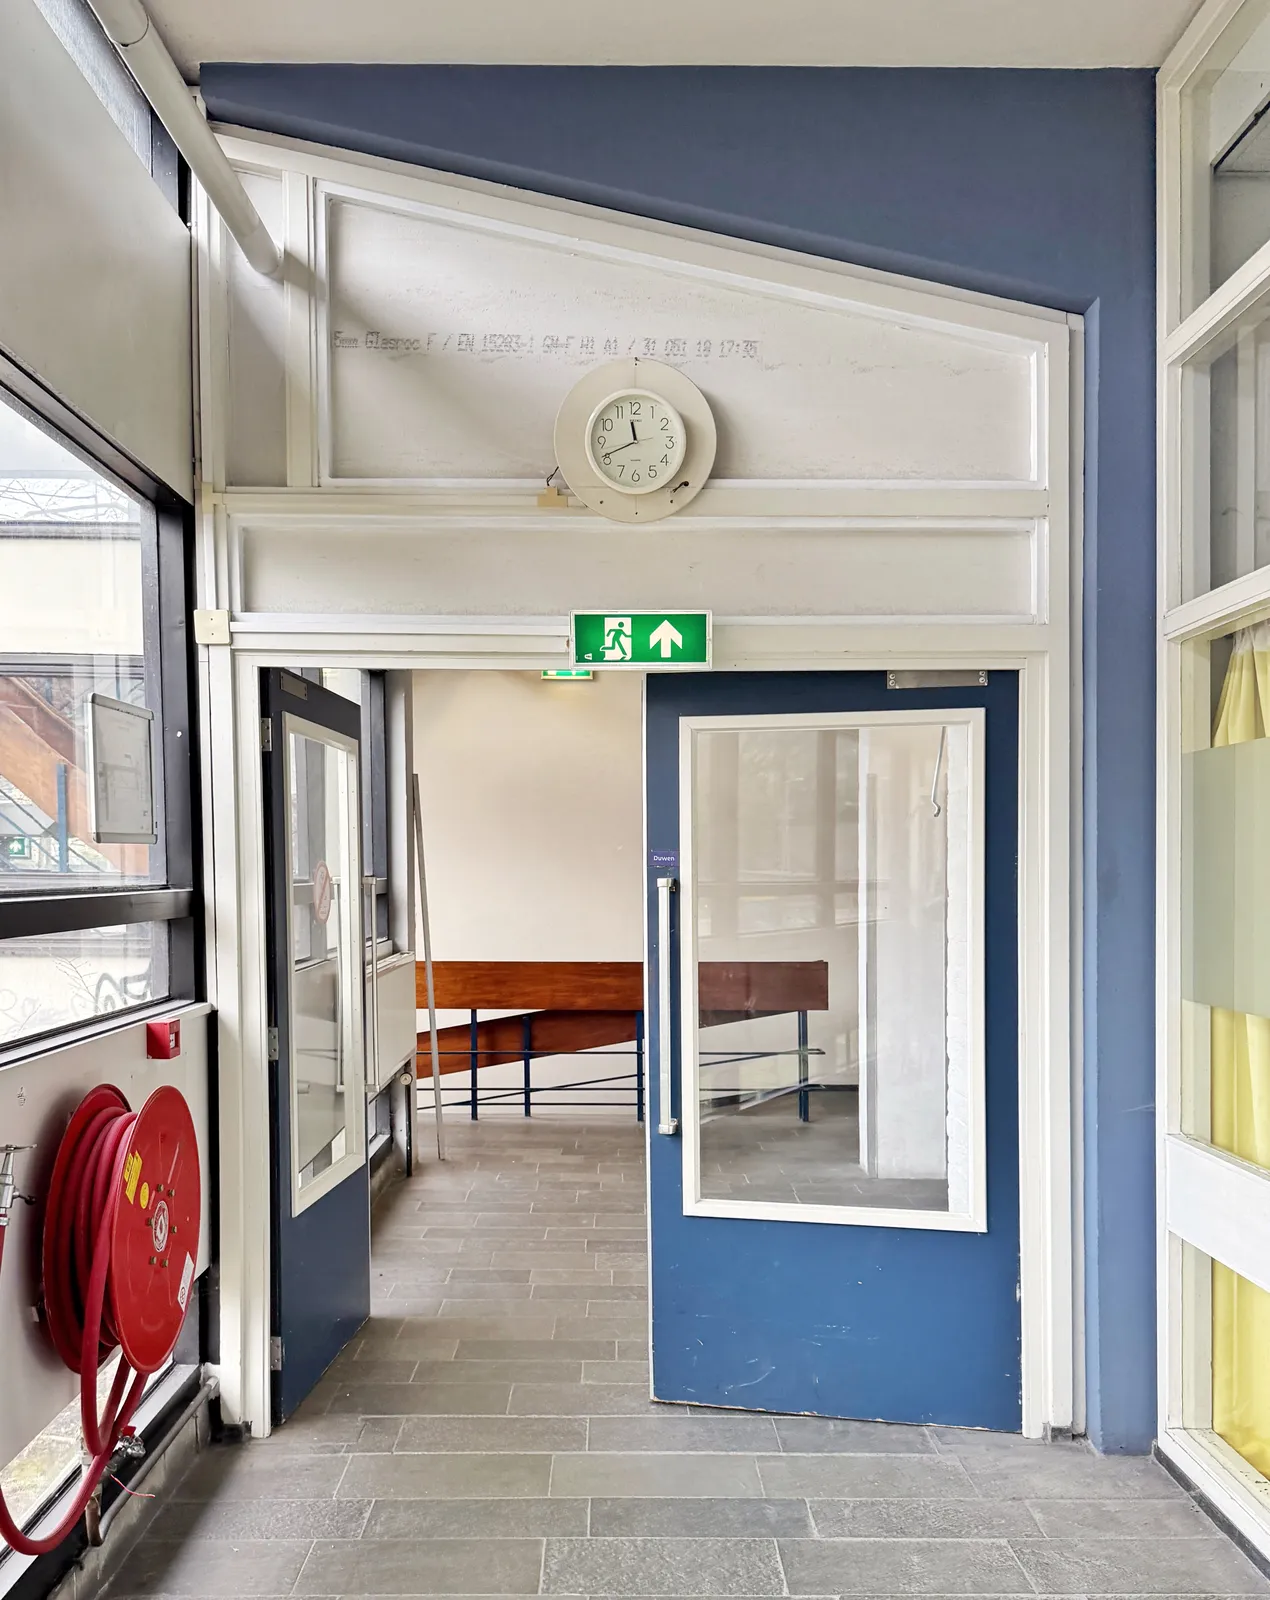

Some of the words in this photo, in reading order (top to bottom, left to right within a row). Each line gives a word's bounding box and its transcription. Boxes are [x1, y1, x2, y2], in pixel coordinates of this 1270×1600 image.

[366, 330, 420, 350] Glasroc
[427, 332, 437, 350] F
[442, 333, 453, 350] /
[615, 406, 624, 419] 11
[629, 402, 641, 415] 12
[601, 418, 614, 432] 10
[660, 417, 669, 431] 2
[597, 436, 606, 449] 9
[665, 436, 675, 449] 3
[603, 453, 612, 466] 8
[660, 453, 669, 467] 4
[617, 465, 625, 478] 7
[631, 469, 640, 482] 6
[648, 465, 657, 478] 5
